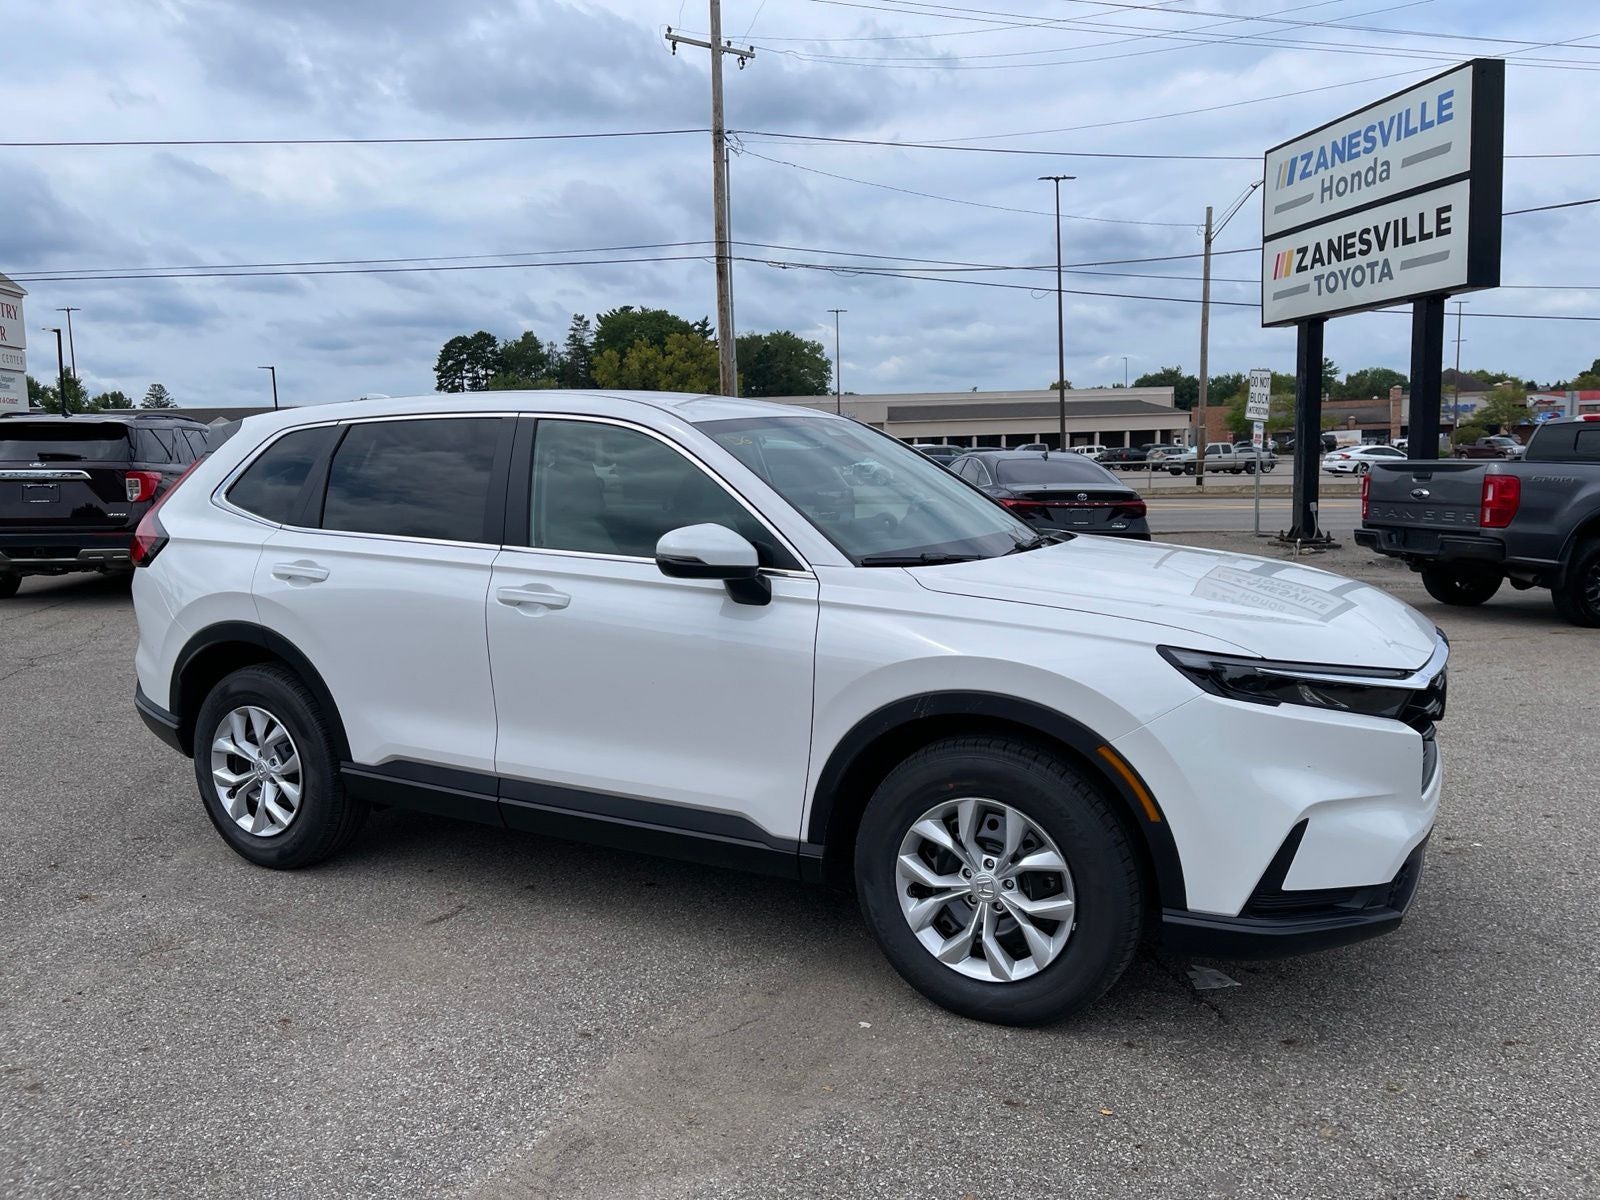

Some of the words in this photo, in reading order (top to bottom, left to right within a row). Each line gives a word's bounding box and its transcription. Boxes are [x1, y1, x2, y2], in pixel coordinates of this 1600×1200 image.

[1299, 90, 1455, 182] ZANESVILLE
[1320, 157, 1391, 204] Honda
[1295, 204, 1453, 274] ZANESVILLE
[1314, 258, 1394, 296] TOYOTA
[1250, 377, 1259, 387] DO
[1260, 377, 1270, 389] NOT
[1247, 406, 1269, 415] INTERSECTION
[1249, 392, 1270, 404] BLOCK
[1370, 506, 1477, 523] RANGER
